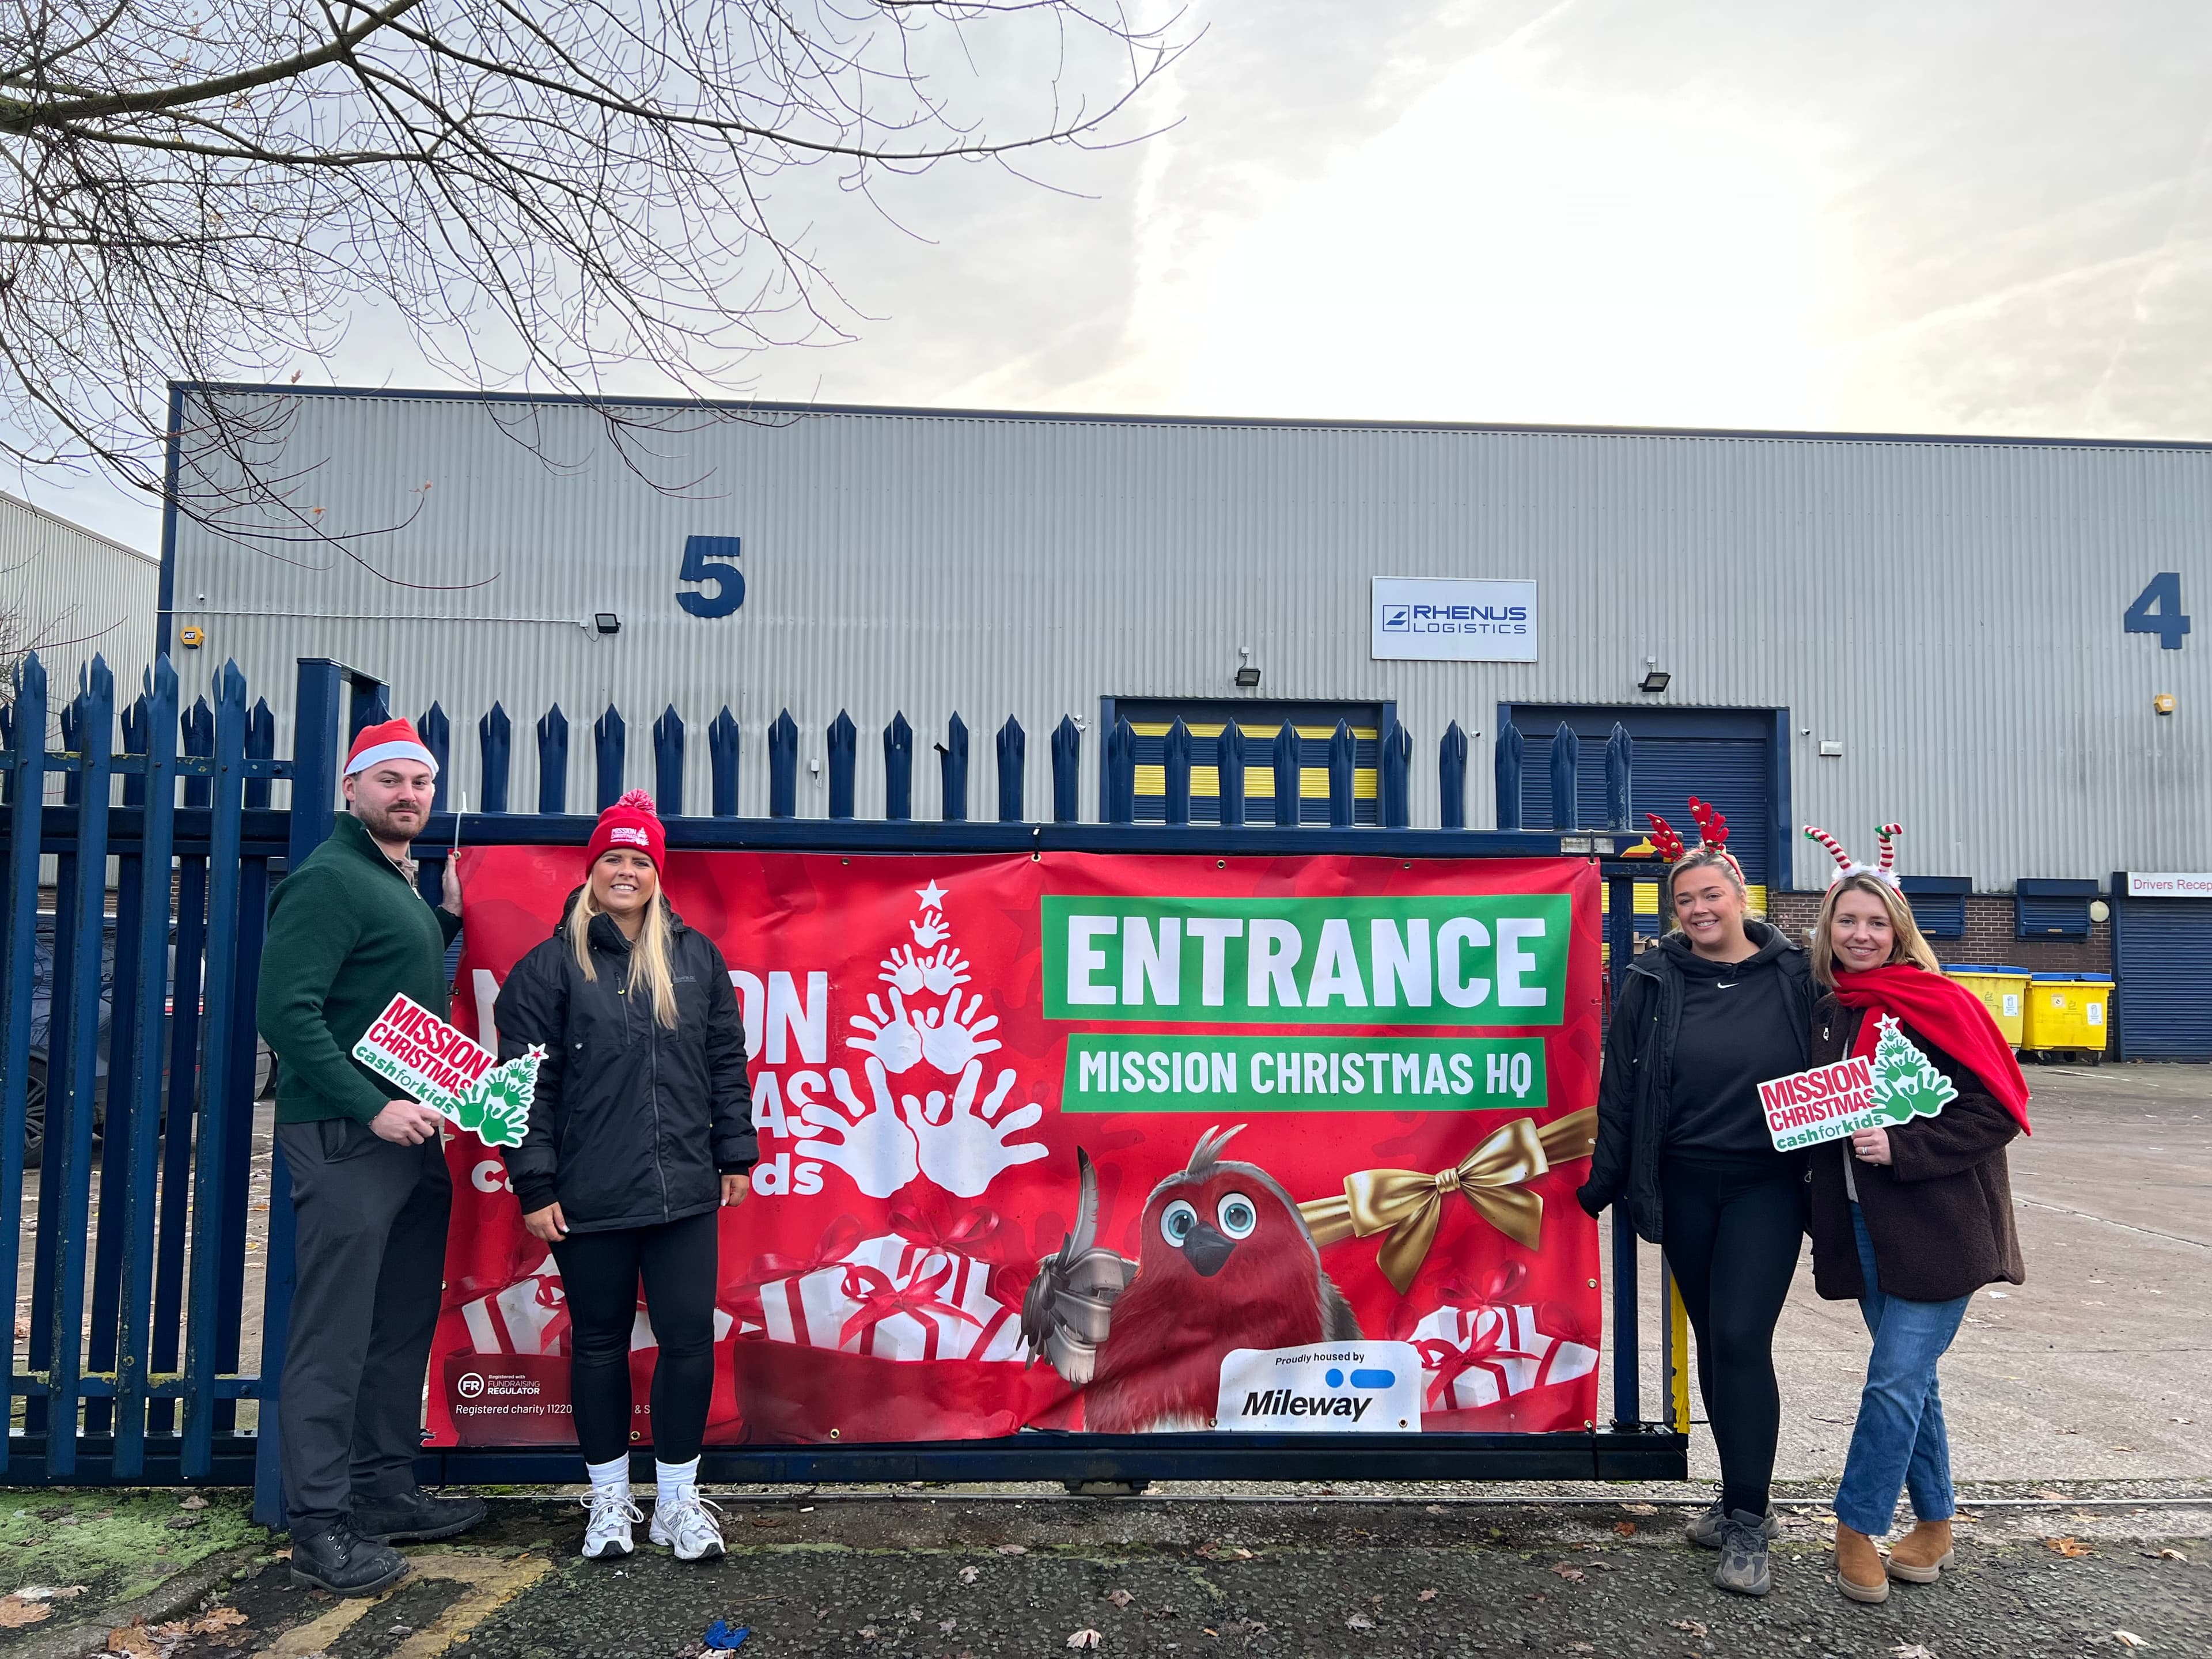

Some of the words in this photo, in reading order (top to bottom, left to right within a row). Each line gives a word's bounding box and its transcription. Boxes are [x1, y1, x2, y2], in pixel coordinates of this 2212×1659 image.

[676, 535, 745, 618] 5
[1414, 605, 1527, 620] RHENUS
[1414, 623, 1527, 634] LOGISTICS
[2124, 572, 2190, 649] 4
[2134, 879, 2173, 889] Drivers
[1067, 915, 1547, 1009] ENTRANCE
[369, 1022, 472, 1099] CHRISTMAS
[382, 997, 493, 1081] MISSION
[355, 1046, 454, 1115] cashforkids
[1079, 1051, 1237, 1093] MISSION
[1251, 1052, 1473, 1095] CHRISTMAS
[1486, 1052, 1532, 1098] HQ
[1761, 1059, 1872, 1111] MISSION
[1769, 1088, 1878, 1132] CHRISTMAS
[1777, 1113, 1884, 1149] cashforkids
[1275, 1354, 1312, 1365] Proudly
[1313, 1352, 1350, 1361] housed
[1353, 1351, 1365, 1363] by
[463, 1380, 480, 1391] FR
[1241, 1389, 1373, 1423] Mileway
[456, 1404, 509, 1416] Registered
[511, 1404, 545, 1416] charity
[634, 1404, 641, 1414] &
